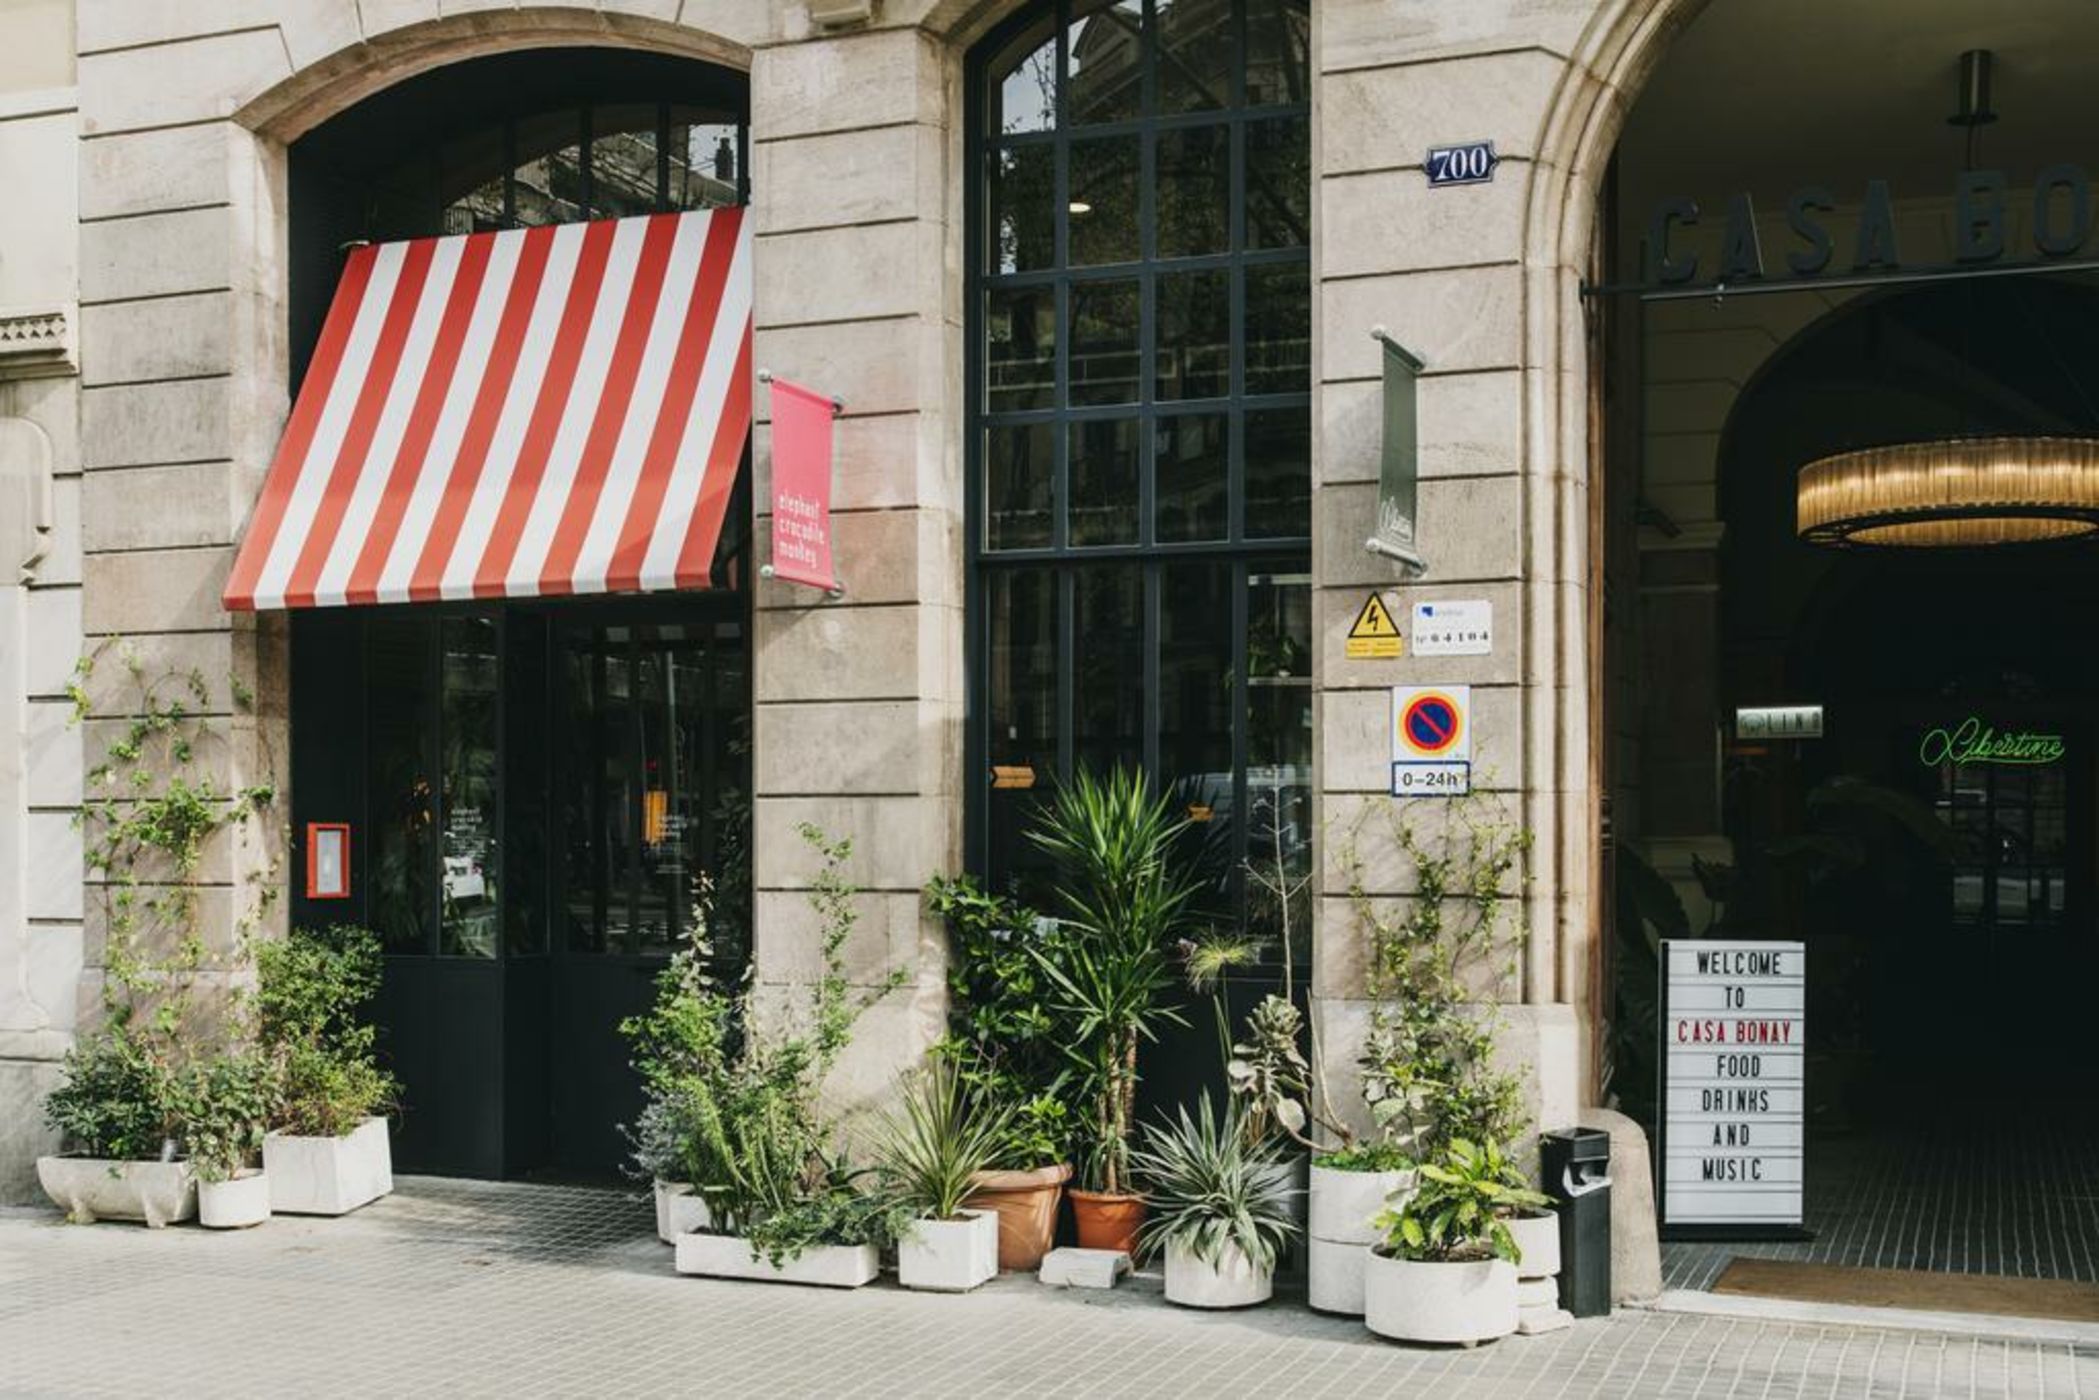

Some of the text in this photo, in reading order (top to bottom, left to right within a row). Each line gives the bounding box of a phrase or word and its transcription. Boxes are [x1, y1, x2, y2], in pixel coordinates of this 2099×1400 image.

[1432, 147, 1487, 181] 700
[1650, 179, 1899, 283] CASA
[779, 488, 820, 520] elephant
[779, 517, 825, 545] crocodile
[779, 540, 817, 569] monkey
[1920, 717, 2066, 767] Libertine
[1697, 951, 1781, 975] WELCOME
[1725, 986, 1744, 1008] TO
[1678, 1020, 1791, 1044] CASA BONAY
[1717, 1055, 1760, 1078] FOOD
[1702, 1089, 1769, 1112] DRINKS
[1713, 1124, 1750, 1147] AND
[1702, 1158, 1762, 1181] MUSIC
